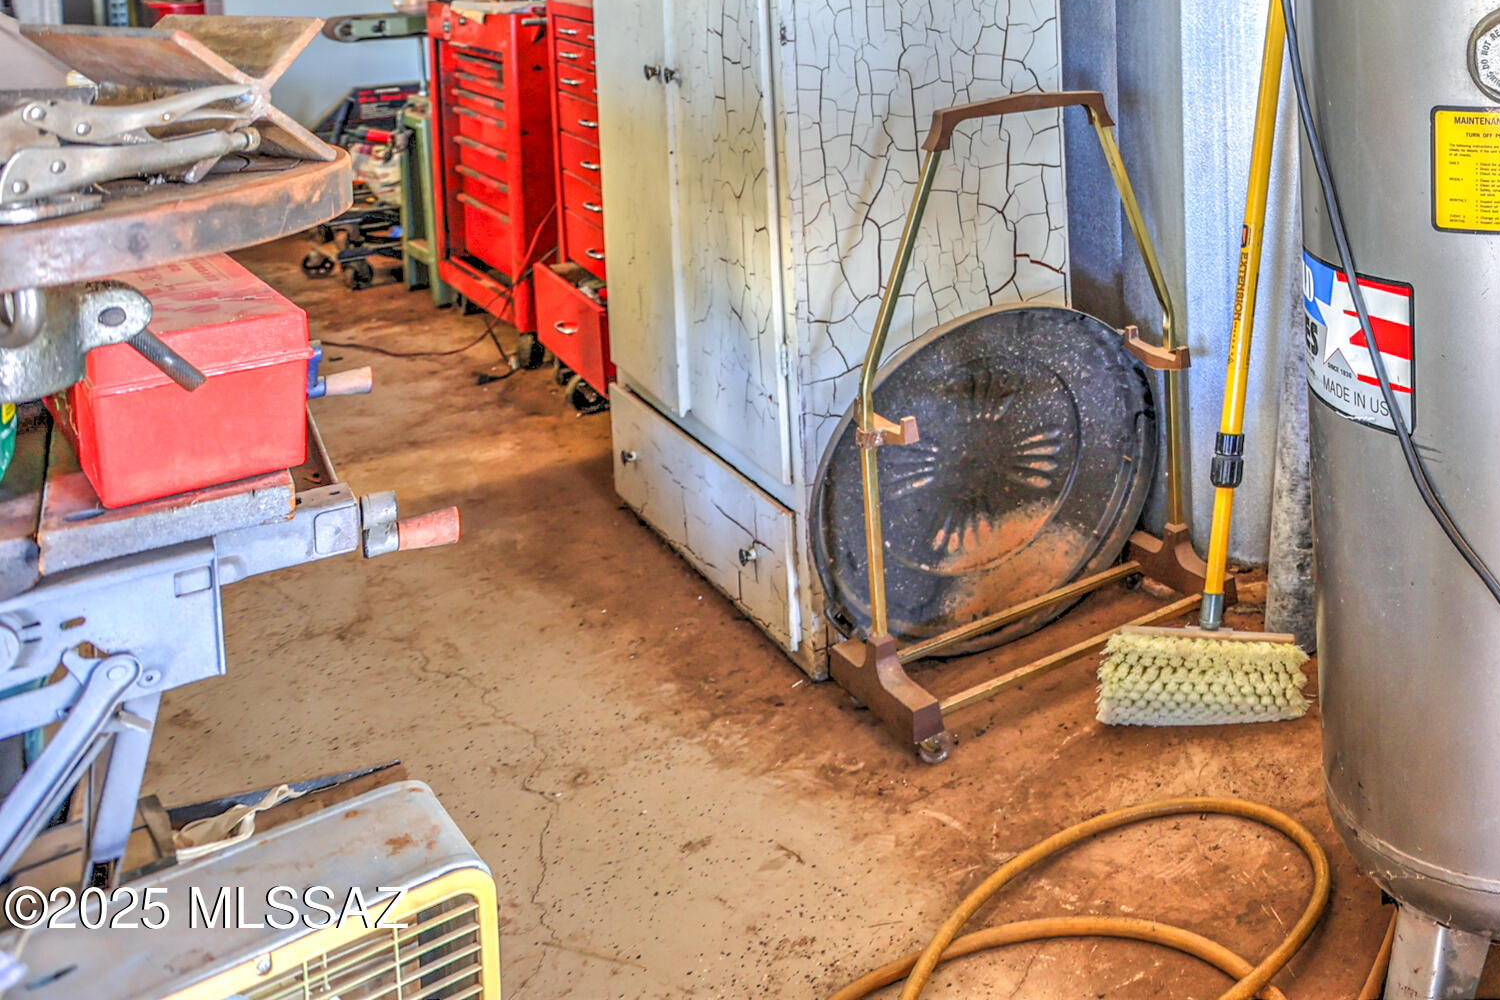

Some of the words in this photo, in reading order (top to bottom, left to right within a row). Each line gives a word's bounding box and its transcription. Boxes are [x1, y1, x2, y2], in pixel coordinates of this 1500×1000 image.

[1481, 40, 1491, 56] NOT
[1234, 252, 1249, 321] EXTENSION
[1323, 375, 1350, 403] MADE
[1354, 391, 1366, 409] IN
[1370, 397, 1390, 417] US
